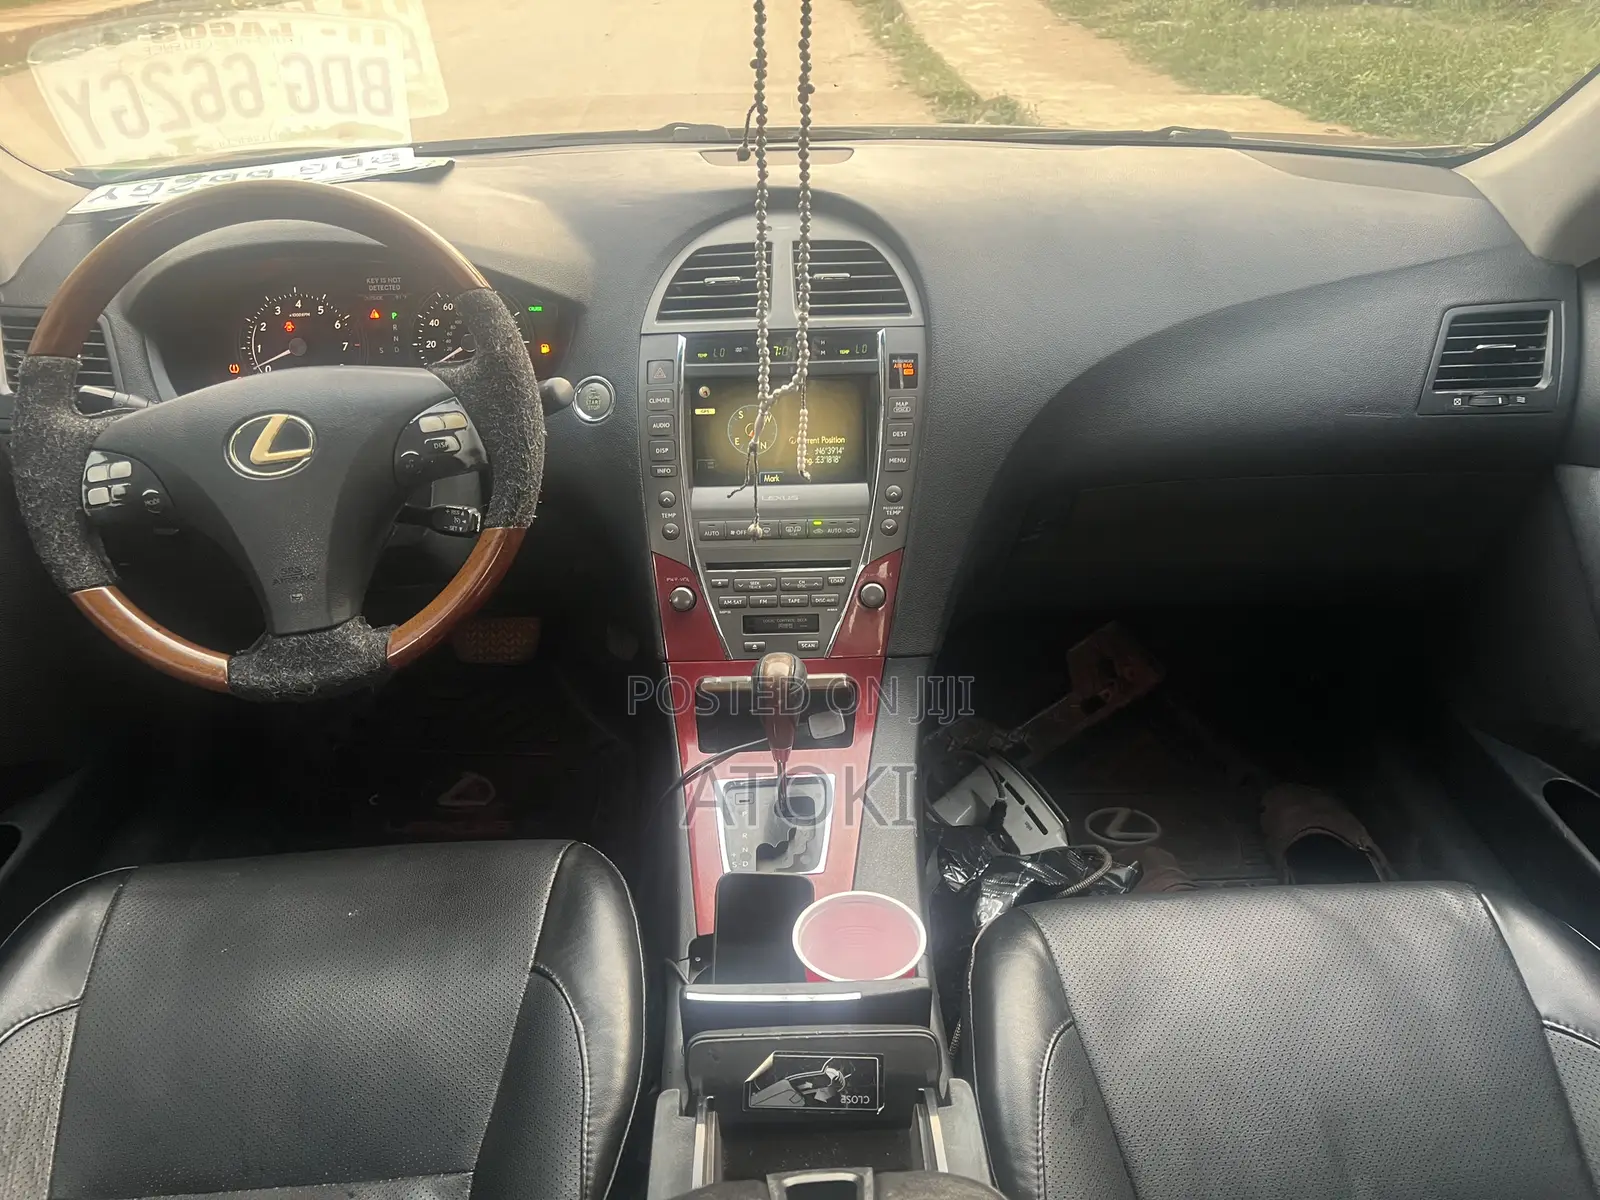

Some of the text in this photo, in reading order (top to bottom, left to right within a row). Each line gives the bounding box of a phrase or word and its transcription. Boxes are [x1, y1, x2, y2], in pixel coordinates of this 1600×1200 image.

[368, 284, 401, 292] DETECTED
[295, 299, 302, 308] 4
[443, 302, 454, 311] 60
[274, 305, 281, 315] 3
[317, 305, 325, 315] 5
[391, 312, 398, 320] P
[259, 322, 267, 332] 2
[334, 320, 341, 330] 6
[392, 323, 398, 331] R
[429, 318, 440, 327] 40
[341, 341, 349, 351] 7
[425, 340, 437, 348] 20
[257, 344, 262, 354] 1
[738, 410, 744, 419] S
[734, 437, 740, 446] E
[821, 436, 846, 444] Position
[760, 441, 767, 450] N
[763, 474, 780, 483] Mark
[840, 1095, 870, 1104] CLOSE
